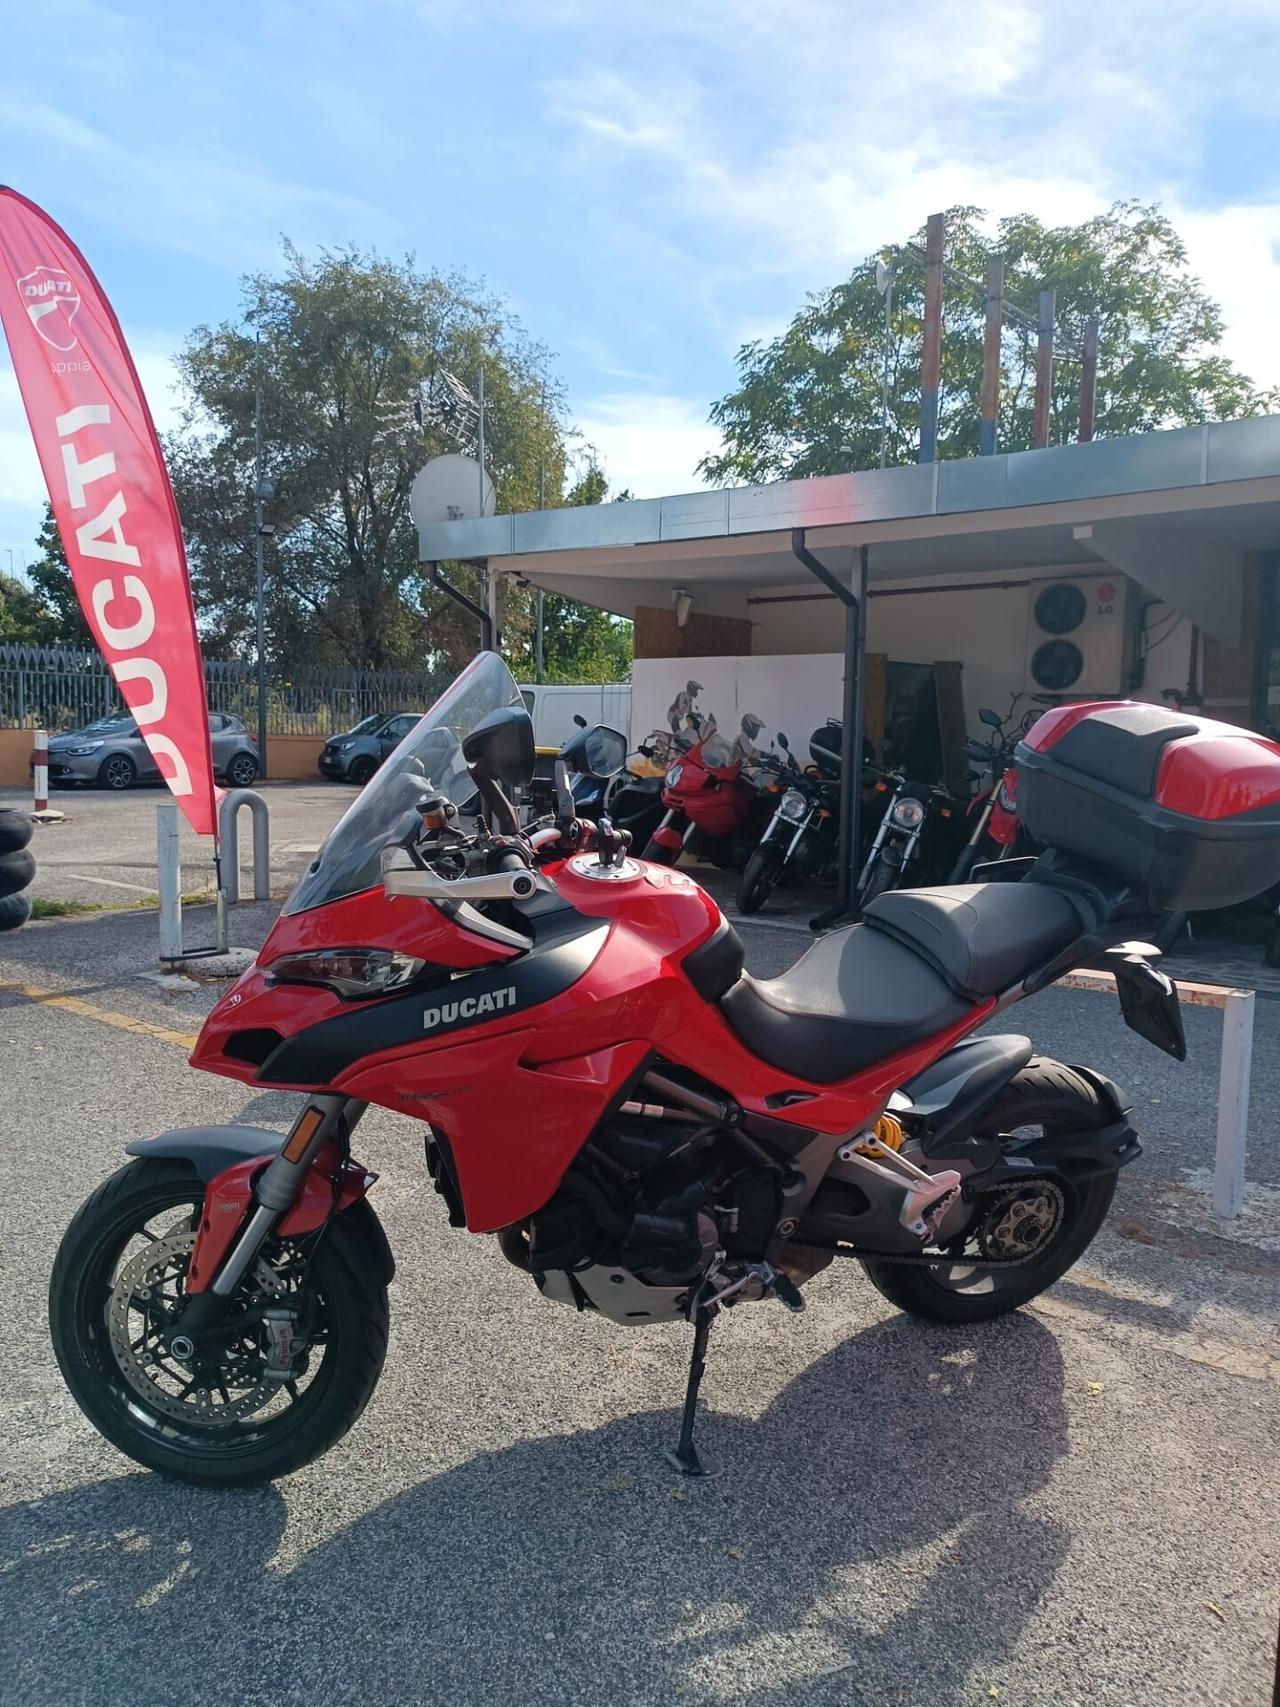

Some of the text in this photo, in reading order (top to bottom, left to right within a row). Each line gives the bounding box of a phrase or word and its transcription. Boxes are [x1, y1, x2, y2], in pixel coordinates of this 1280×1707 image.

[55, 404, 194, 797] DUCATI
[1097, 605, 1114, 614] LG
[423, 986, 517, 1029] DUCATI
